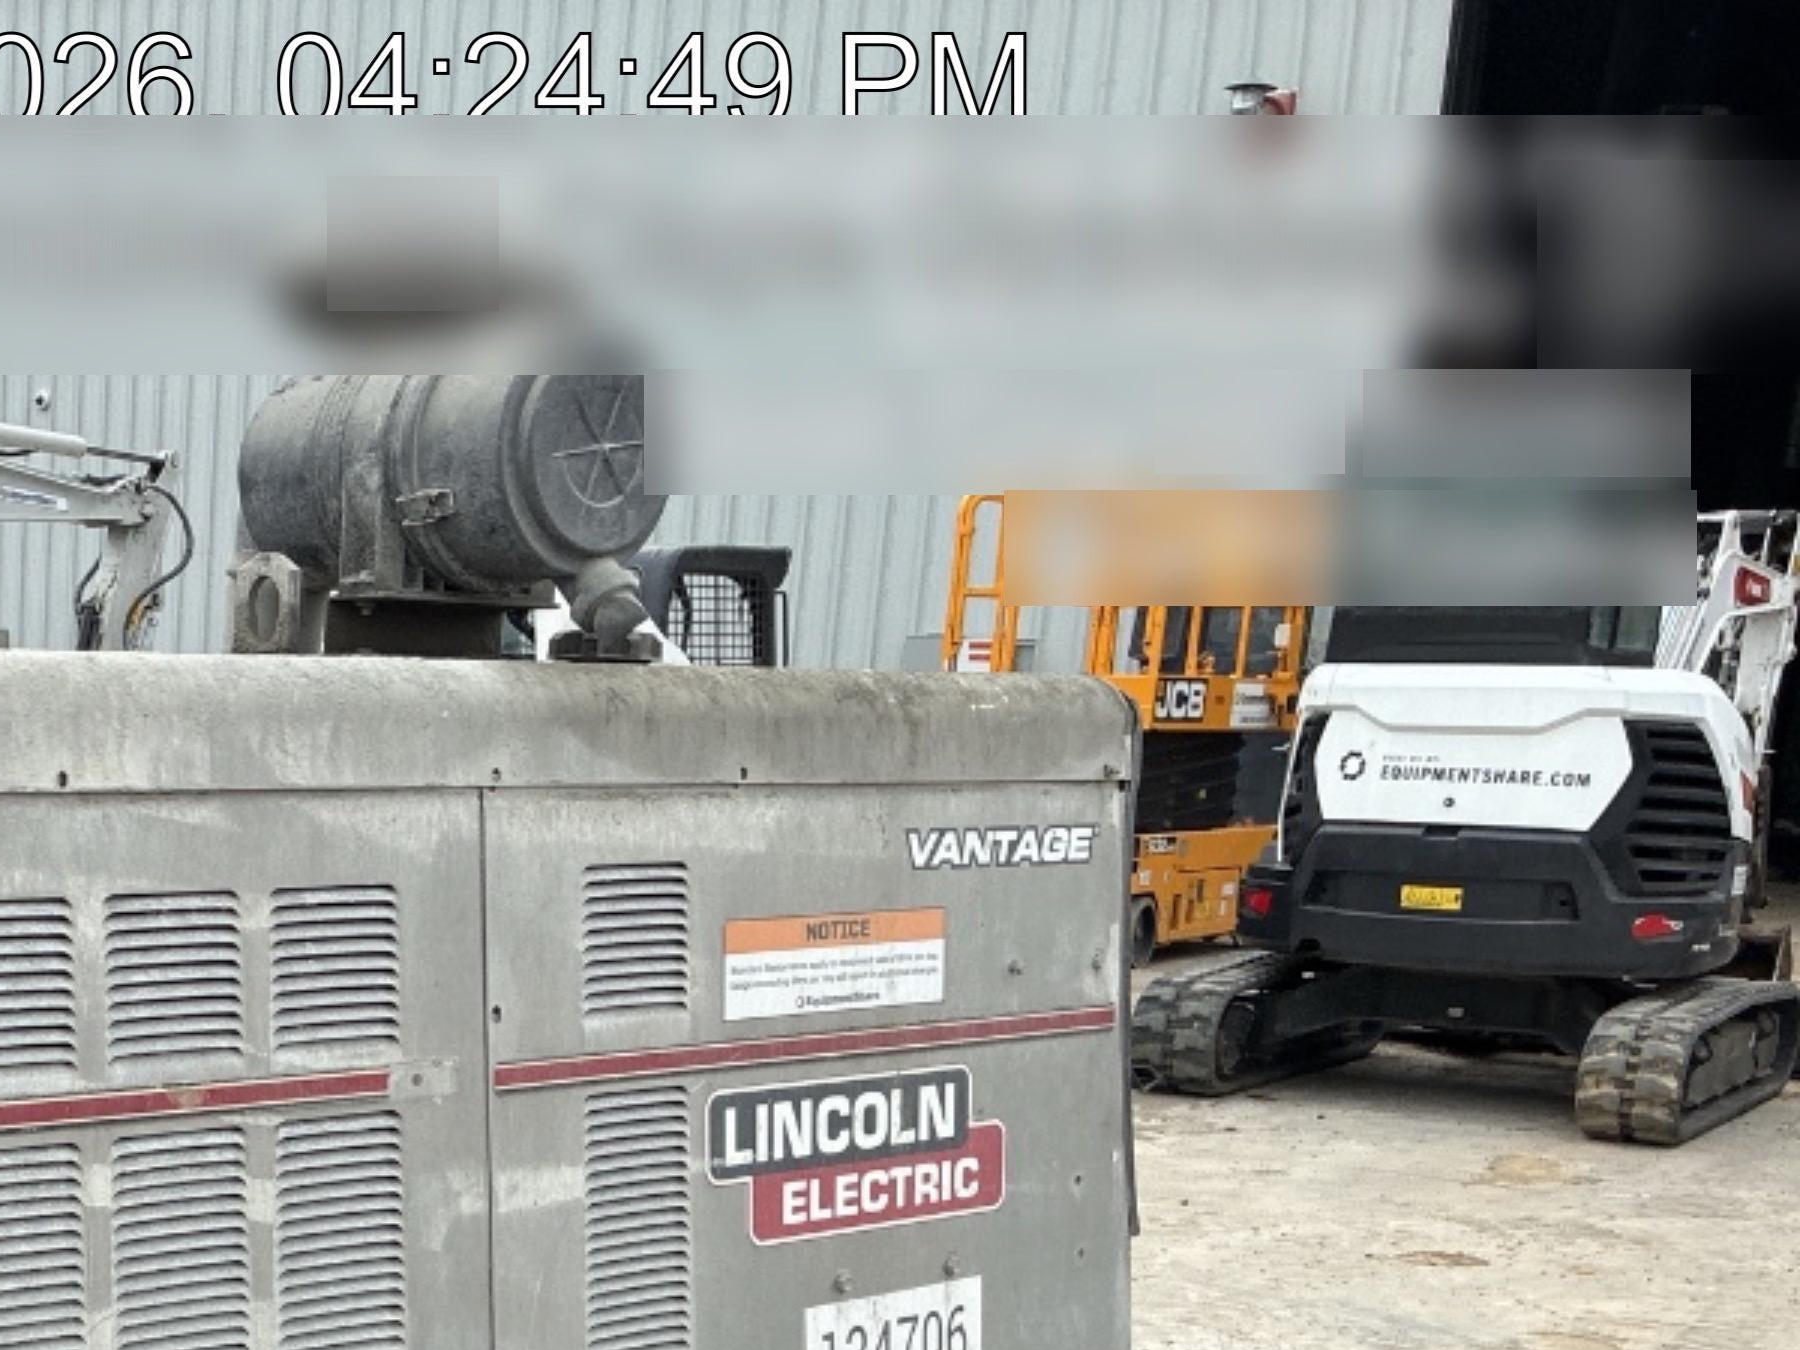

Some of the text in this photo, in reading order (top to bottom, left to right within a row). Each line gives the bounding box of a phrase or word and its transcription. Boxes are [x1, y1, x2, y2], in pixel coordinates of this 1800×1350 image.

[1154, 680, 1208, 719] JCB
[1380, 763, 1592, 788] EQUIPMENTSHARE.COM
[906, 824, 1096, 869] VANTAGE
[806, 919, 872, 941] NOTICE
[724, 1082, 956, 1167] LINCOLN
[781, 1156, 980, 1226] ELECTRIC
